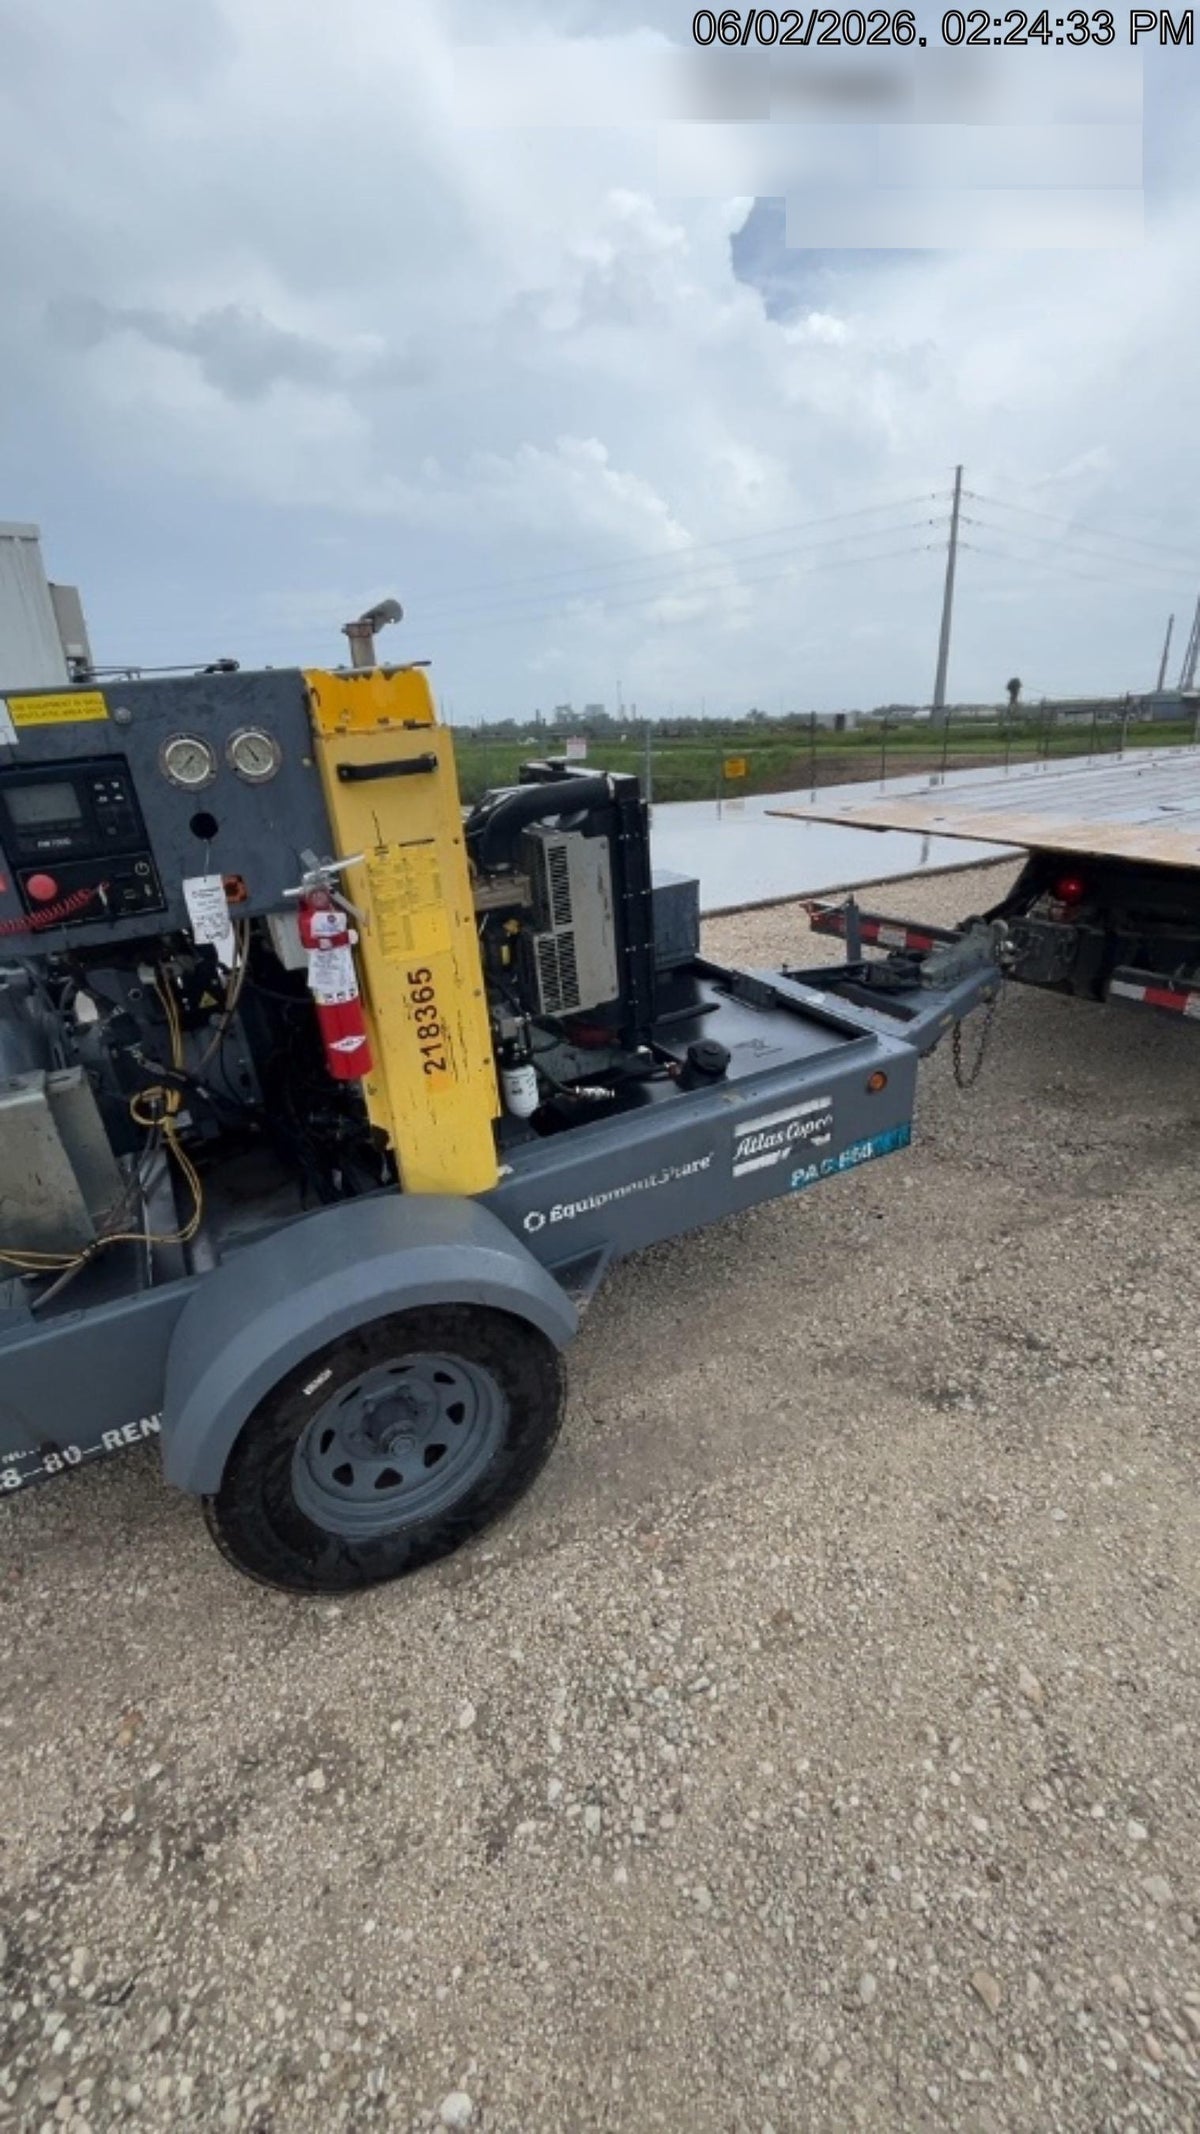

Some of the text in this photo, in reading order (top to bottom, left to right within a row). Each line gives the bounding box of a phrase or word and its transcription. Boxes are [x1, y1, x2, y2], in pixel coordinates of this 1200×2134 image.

[407, 967, 447, 1075] 218365
[732, 1132, 785, 1161] Atlas
[791, 1158, 836, 1188] PAC
